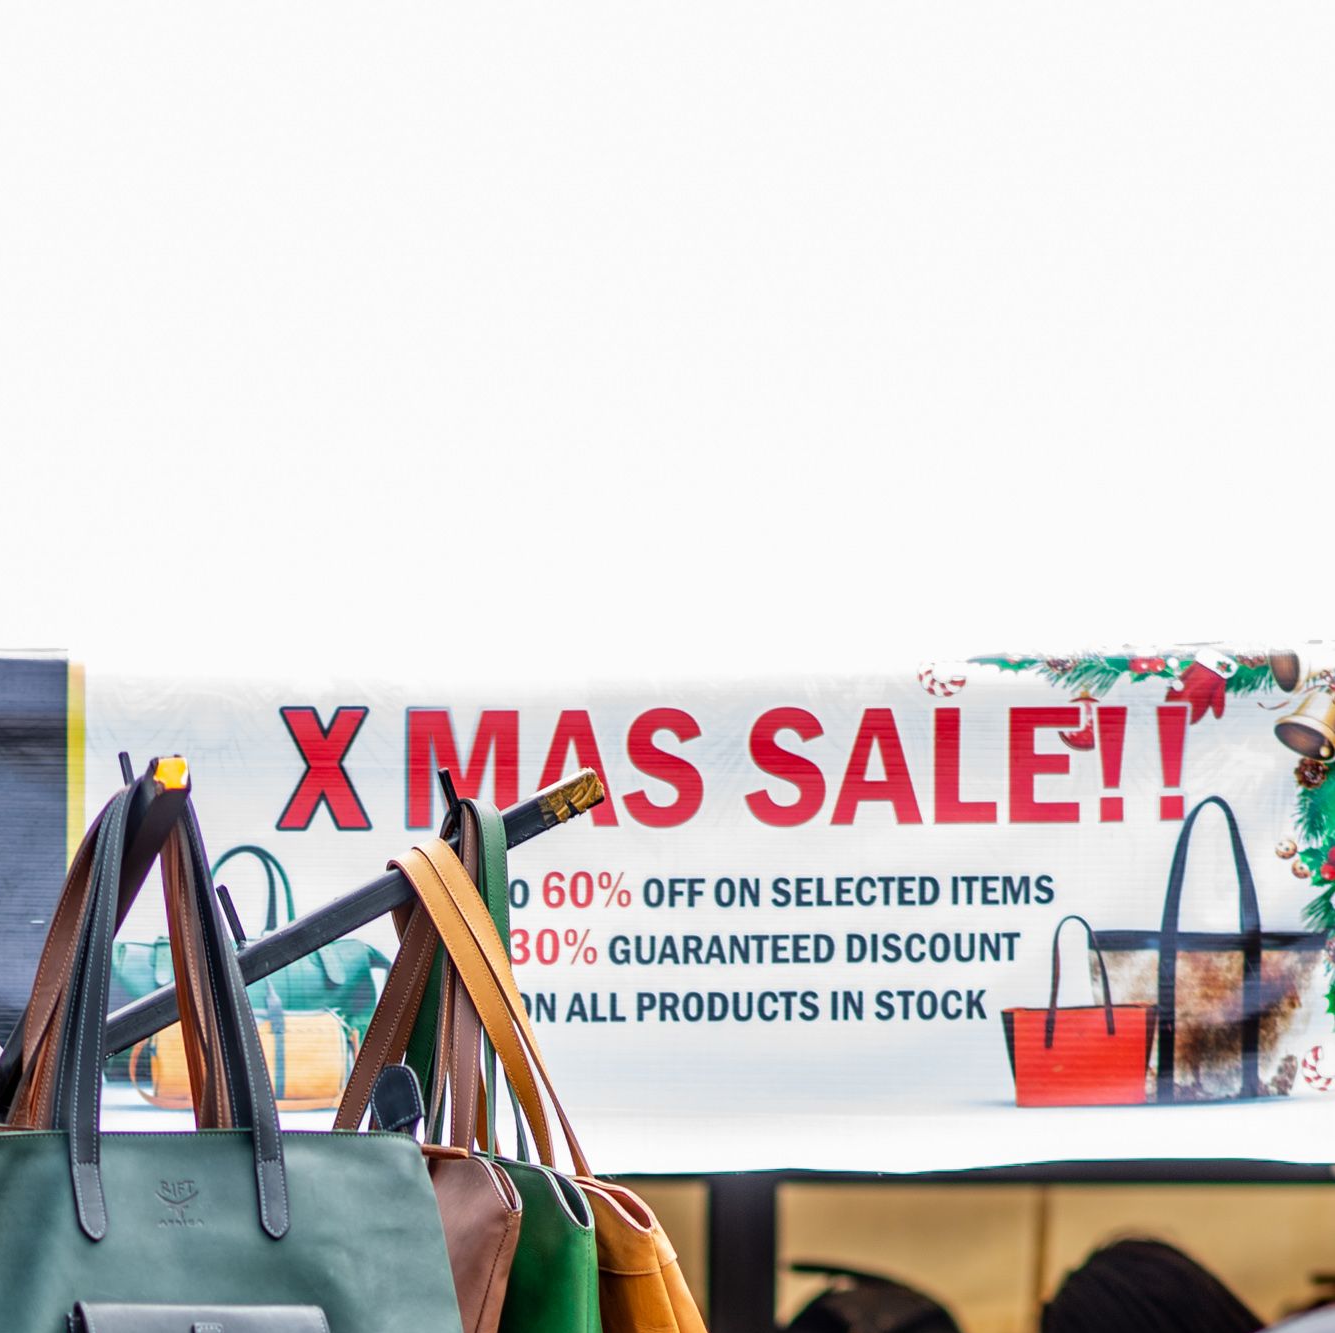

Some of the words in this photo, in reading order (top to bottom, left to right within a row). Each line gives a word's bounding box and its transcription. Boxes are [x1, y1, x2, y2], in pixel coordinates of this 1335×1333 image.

[275, 705, 373, 832] X
[405, 706, 705, 828] MAS
[744, 705, 1189, 828] SALE!!
[542, 870, 633, 910] 60%
[643, 877, 706, 909] OFF
[715, 876, 761, 908] ON
[771, 875, 941, 908] SELECTED
[951, 874, 1055, 906] ITEMS
[510, 927, 599, 966] 30%
[608, 932, 835, 966] GUARANTEED
[846, 931, 1021, 963] DISCOUNT
[565, 992, 627, 1023] ALL
[636, 991, 820, 1023] PRODUCTS
[831, 990, 864, 1021] IN
[874, 989, 988, 1021] STOCK
[160, 1179, 195, 1198] RIFT
